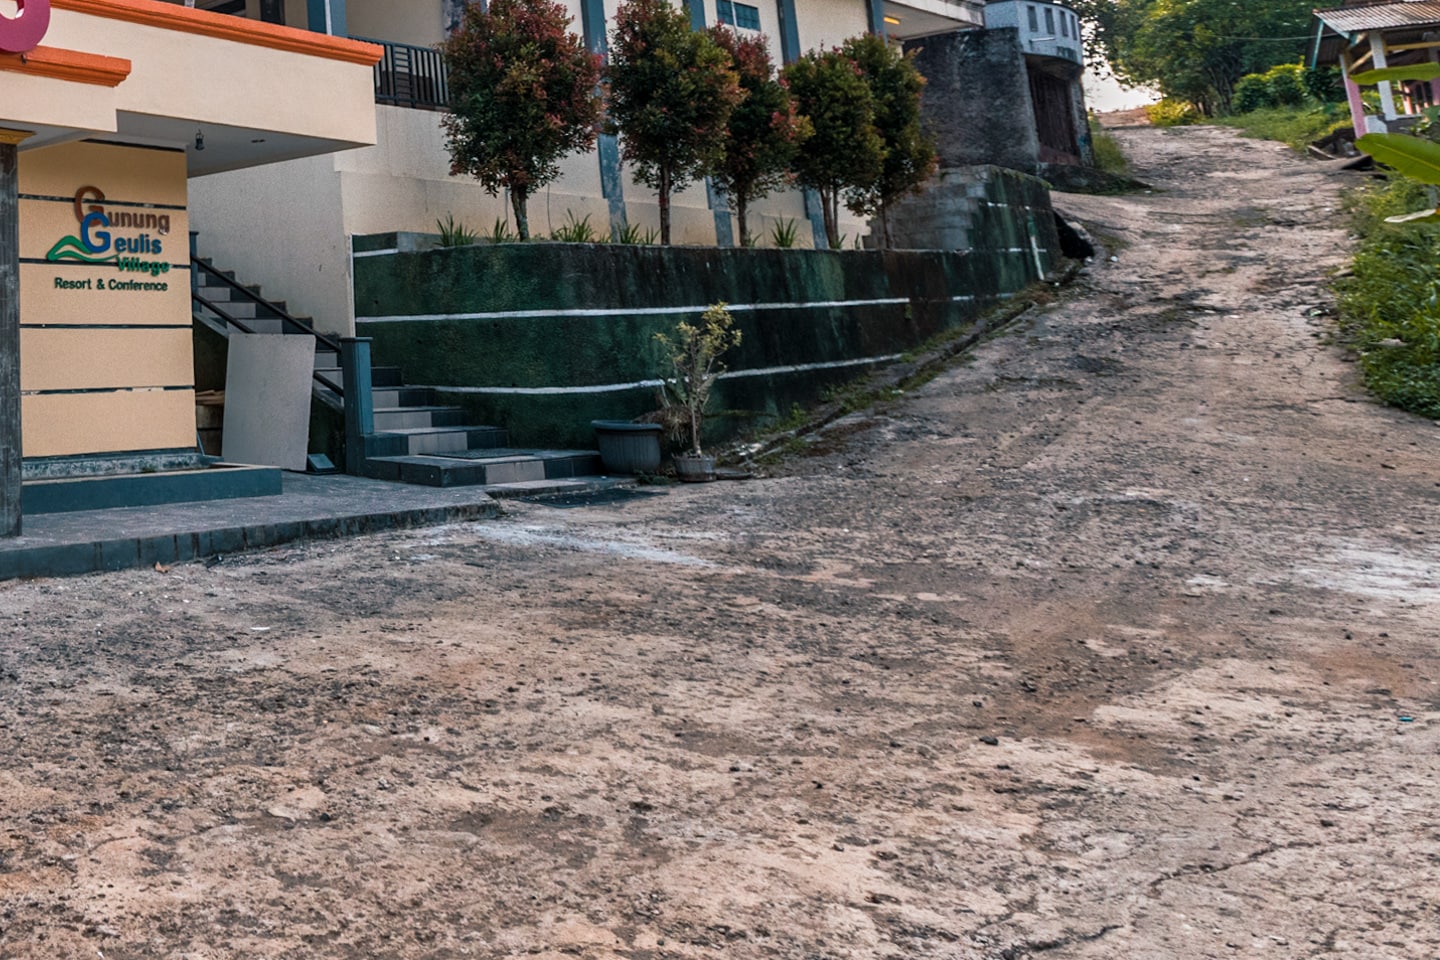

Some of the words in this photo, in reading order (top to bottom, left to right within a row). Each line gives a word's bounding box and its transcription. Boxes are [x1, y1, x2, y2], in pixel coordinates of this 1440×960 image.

[74, 185, 170, 235] Gunung
[81, 211, 162, 254] Geulis
[116, 256, 170, 276] Village
[54, 277, 92, 290] Resort
[96, 278, 105, 290] &
[108, 279, 168, 291] Conference
